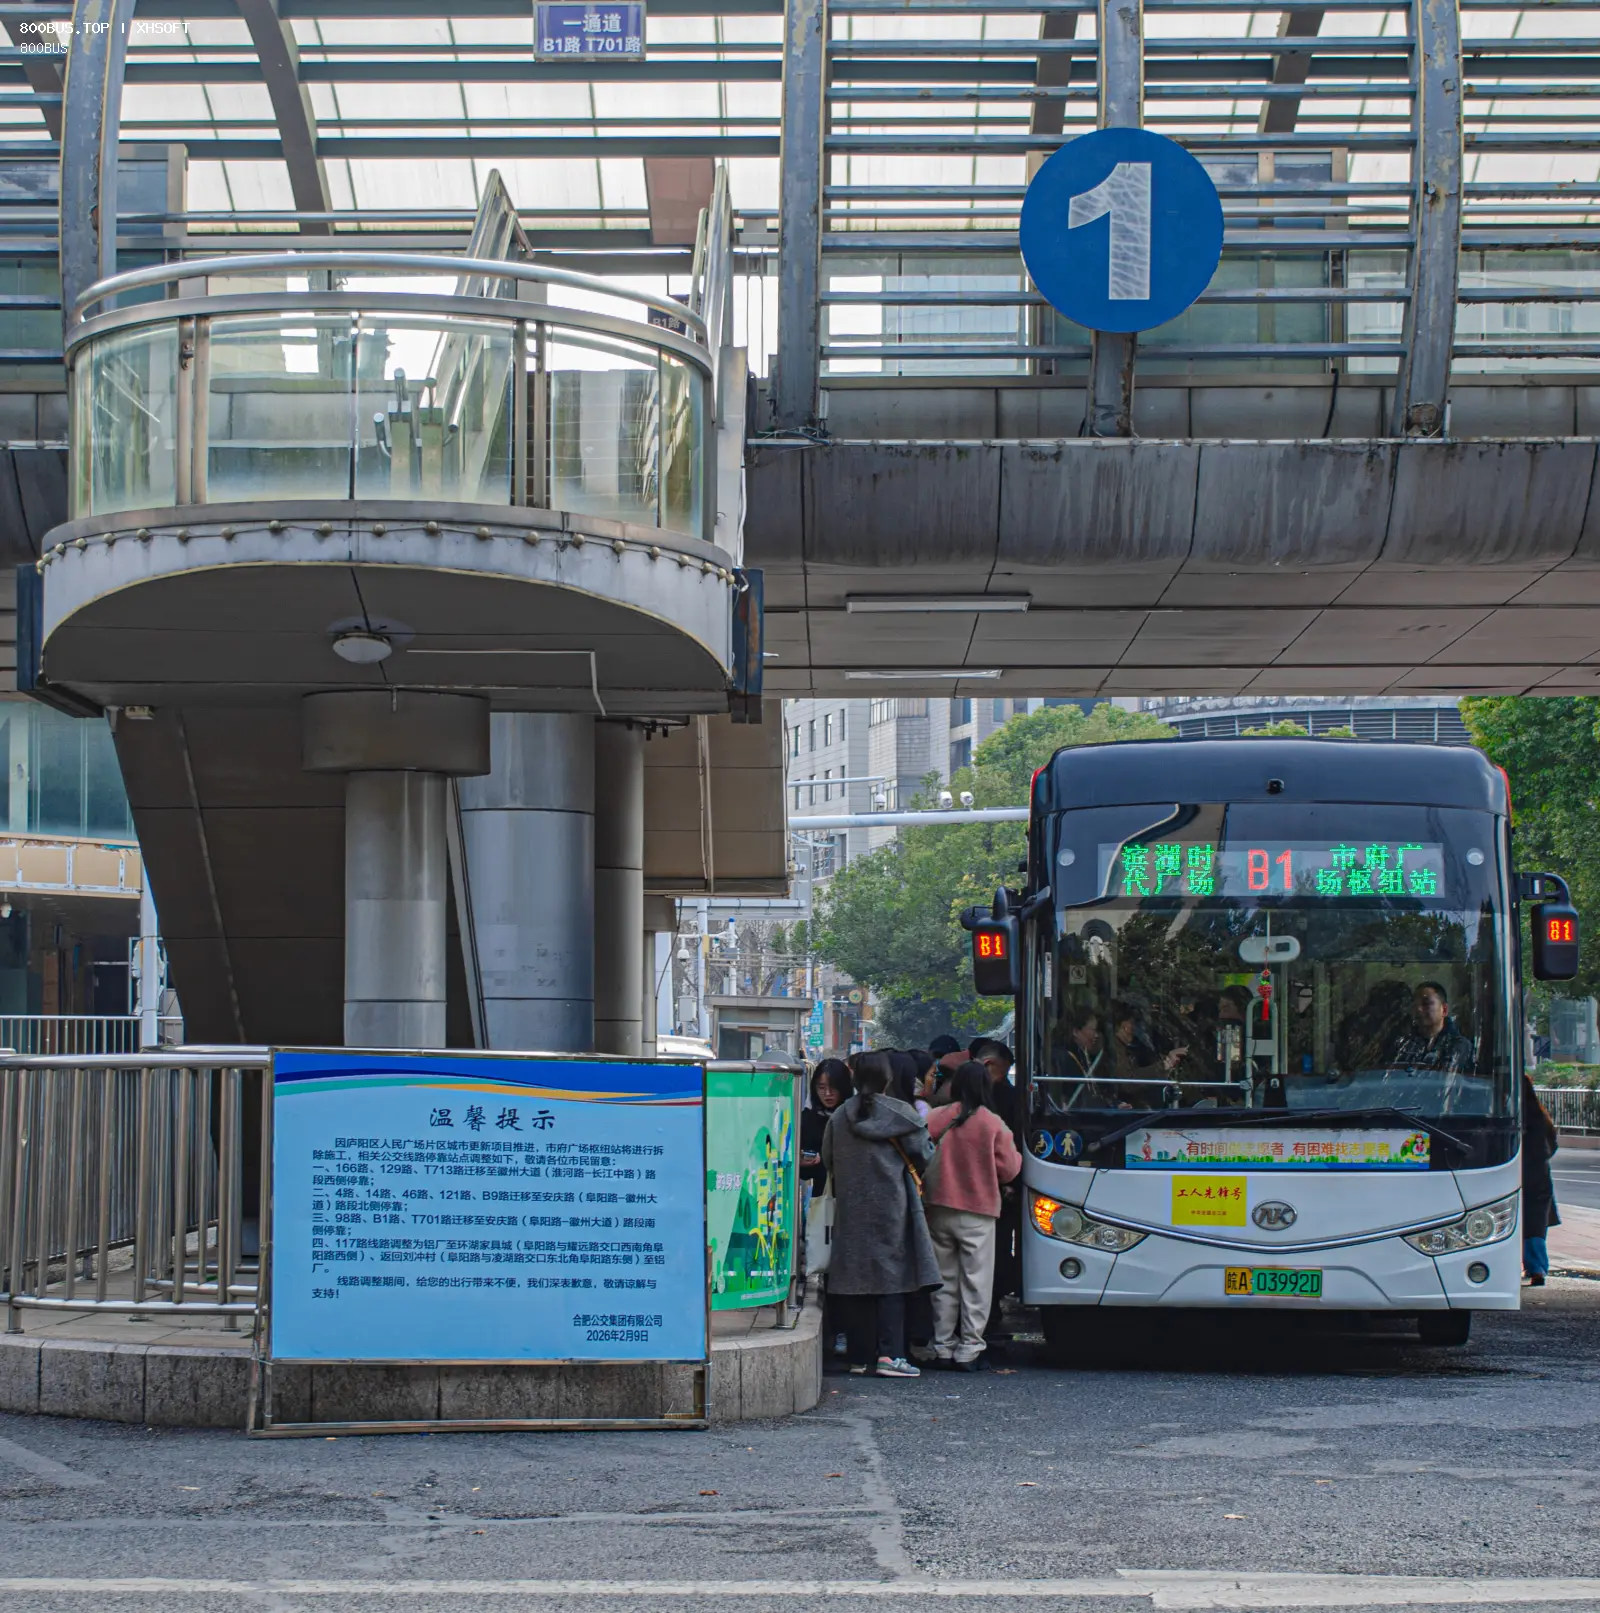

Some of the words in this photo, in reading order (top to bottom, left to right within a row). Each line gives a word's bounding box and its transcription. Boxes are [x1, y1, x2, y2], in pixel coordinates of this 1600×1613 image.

[563, 13, 622, 33] 一通道
[543, 36, 581, 53] B1路
[585, 36, 641, 53] T701路
[1068, 161, 1152, 300] 1
[1122, 844, 1215, 869] 滨湖时
[1329, 844, 1424, 869] 市府广
[1247, 848, 1293, 890] B1
[1316, 868, 1437, 895] 场枢纽站
[979, 934, 1003, 957] B1
[429, 1104, 556, 1132] 温馨提示
[1292, 1141, 1390, 1156] 有困难找志愿者
[312, 1175, 375, 1187] 段西侧停靠；
[1176, 1186, 1242, 1200] 工人先锋号
[312, 1226, 352, 1236] 侧停靠；
[573, 1314, 663, 1327] 合肥公交集团有限公司
[586, 1329, 649, 1343] 2026年2月9日
